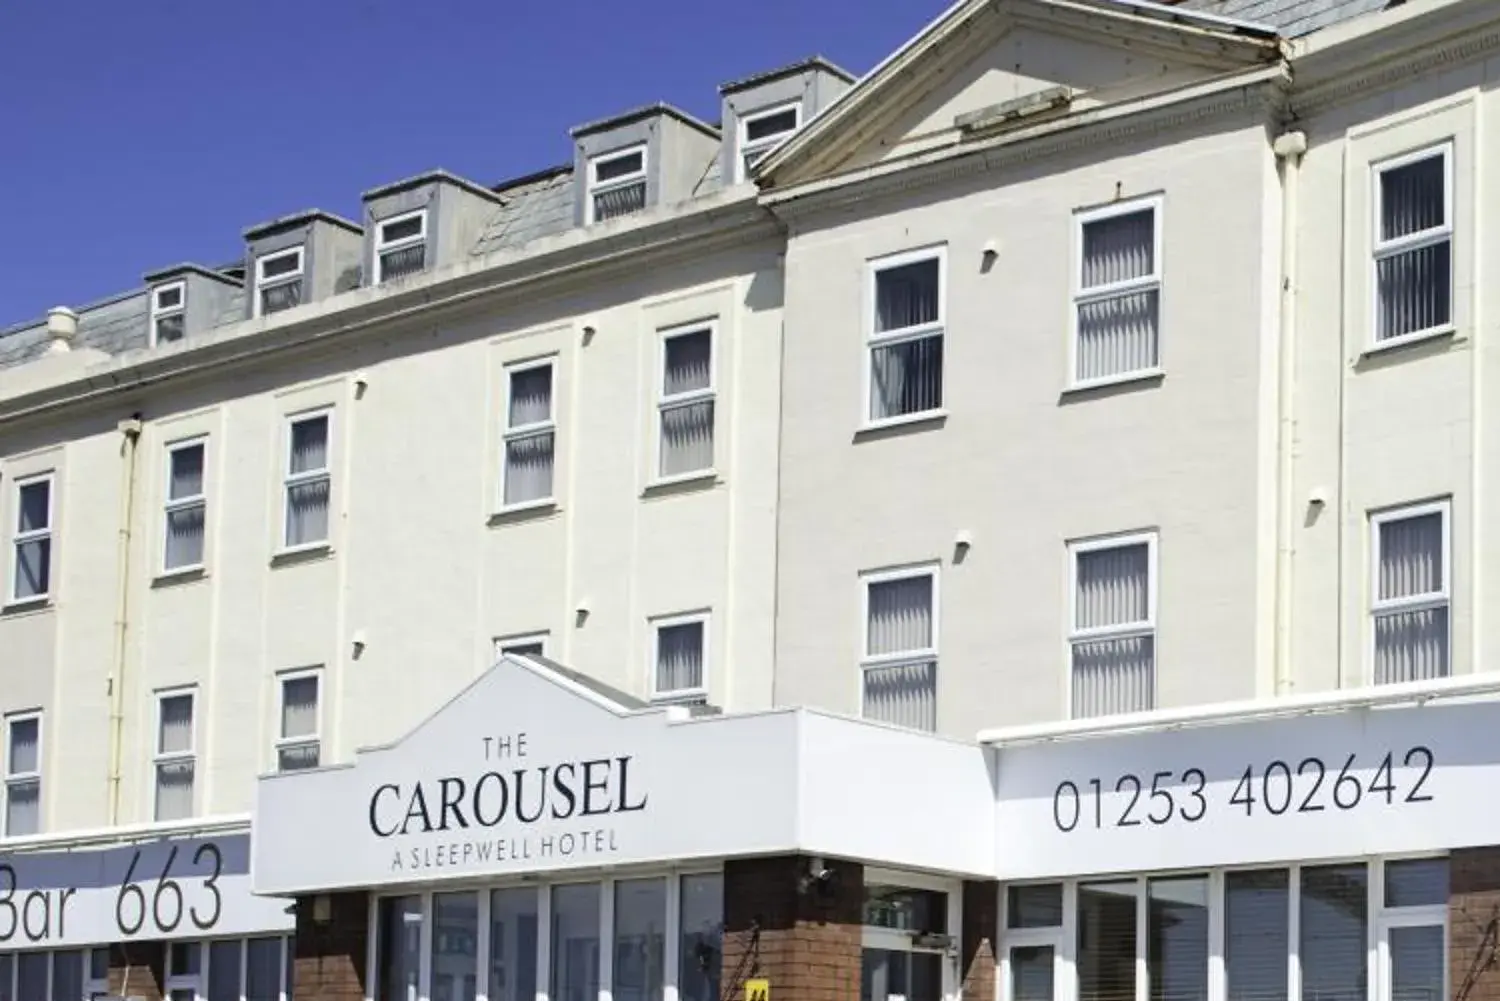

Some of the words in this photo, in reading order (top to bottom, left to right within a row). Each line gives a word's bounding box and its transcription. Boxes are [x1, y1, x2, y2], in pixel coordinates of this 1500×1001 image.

[482, 733, 528, 760] THE
[369, 755, 649, 838] CAROUSEL
[1053, 767, 1207, 833] 01253
[1229, 746, 1434, 817] 402642
[116, 842, 223, 936] 663
[391, 852, 403, 871] A
[410, 837, 532, 870] SLEEPWELL
[541, 829, 619, 858] HOTEL
